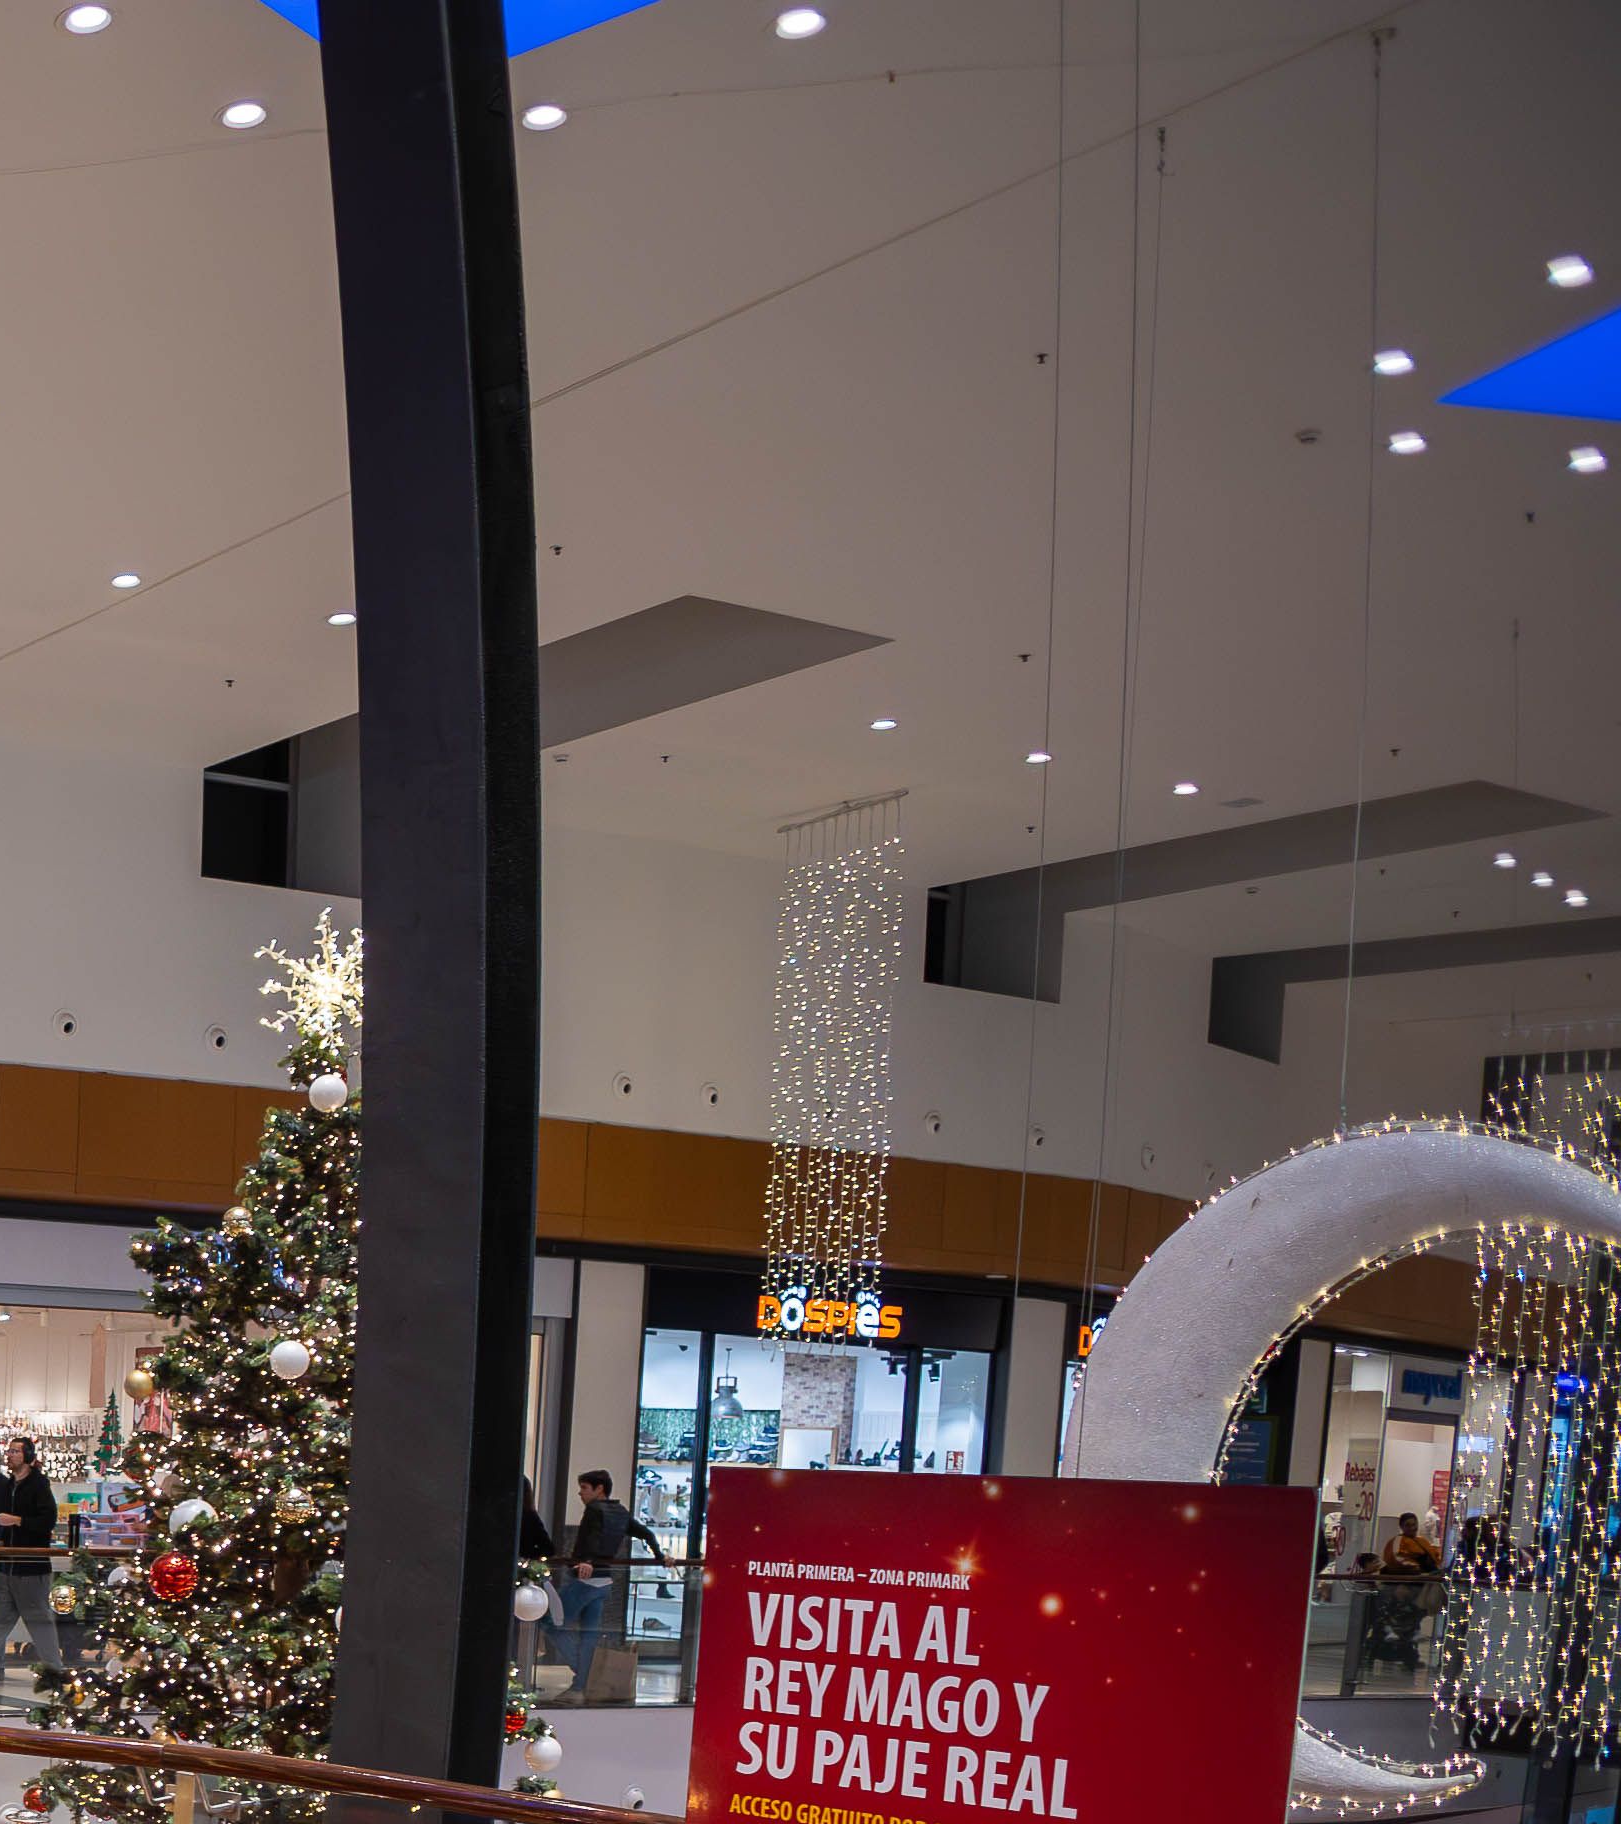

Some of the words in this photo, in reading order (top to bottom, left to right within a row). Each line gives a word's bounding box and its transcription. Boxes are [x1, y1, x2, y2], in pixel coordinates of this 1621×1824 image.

[748, 1561, 794, 1579] PLANTA
[797, 1564, 854, 1582] PRIMERA
[869, 1568, 904, 1585] ZONA
[907, 1571, 970, 1590] PRIMARK
[748, 1592, 901, 1659] VISITA
[914, 1605, 980, 1666] AL
[743, 1656, 836, 1718] REY
[844, 1666, 1000, 1737] MAGO
[1013, 1682, 1050, 1743] Y
[729, 1793, 793, 1821] ACCESO
[736, 1721, 799, 1780] SU
[811, 1729, 930, 1799] PAJE
[943, 1745, 1078, 1820] REAL
